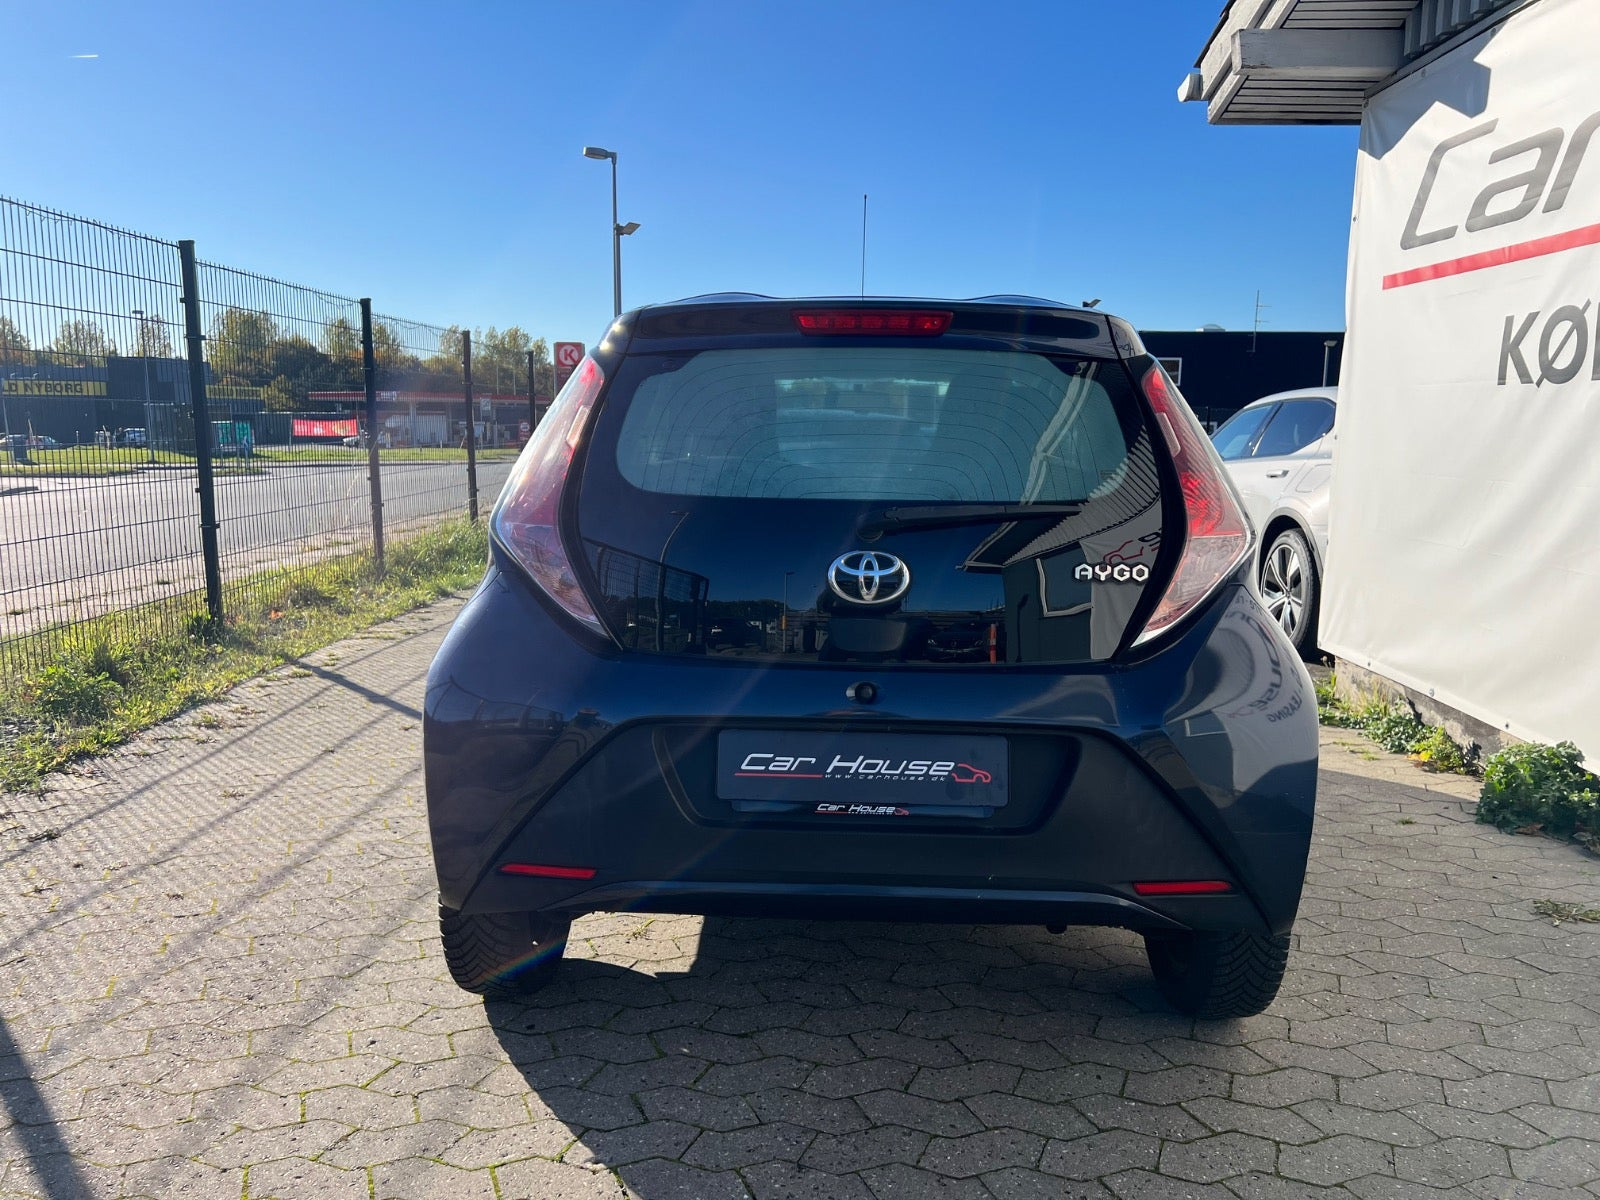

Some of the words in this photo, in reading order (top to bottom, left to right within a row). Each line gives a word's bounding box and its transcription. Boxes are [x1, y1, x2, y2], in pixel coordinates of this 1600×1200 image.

[1400, 110, 1600, 250] Car
[1497, 298, 1600, 388] KØ
[563, 349, 578, 364] K
[24, 382, 83, 393] NYBORG
[1074, 563, 1149, 582] AYGO
[740, 753, 817, 771] Car
[826, 755, 956, 775] House
[825, 773, 946, 782] www.carhouse.dk
[817, 803, 846, 811] Car
[848, 804, 896, 812] House
